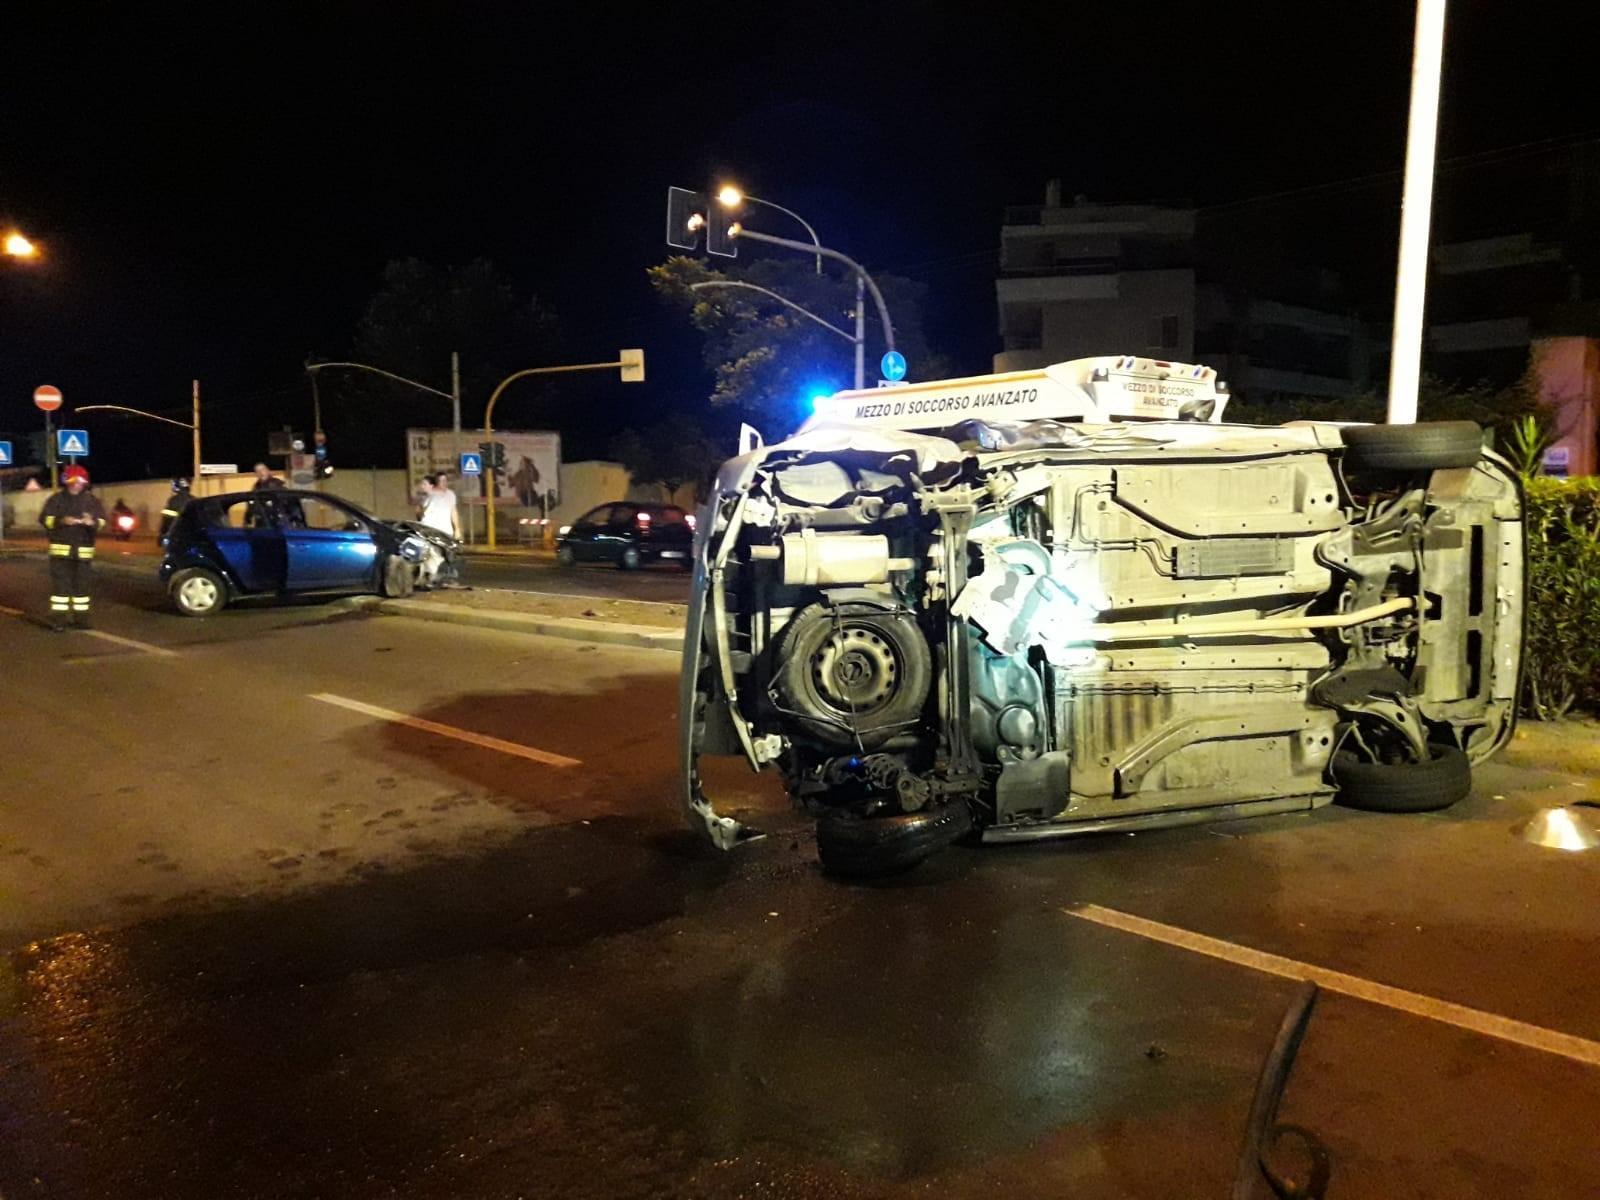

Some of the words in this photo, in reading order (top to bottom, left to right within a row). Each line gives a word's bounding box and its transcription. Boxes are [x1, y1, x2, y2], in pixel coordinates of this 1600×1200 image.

[855, 403, 890, 418] MEZZO
[894, 402, 905, 415] DI
[908, 396, 969, 414] SOCCORSO
[972, 388, 1037, 408] AVANZATO
